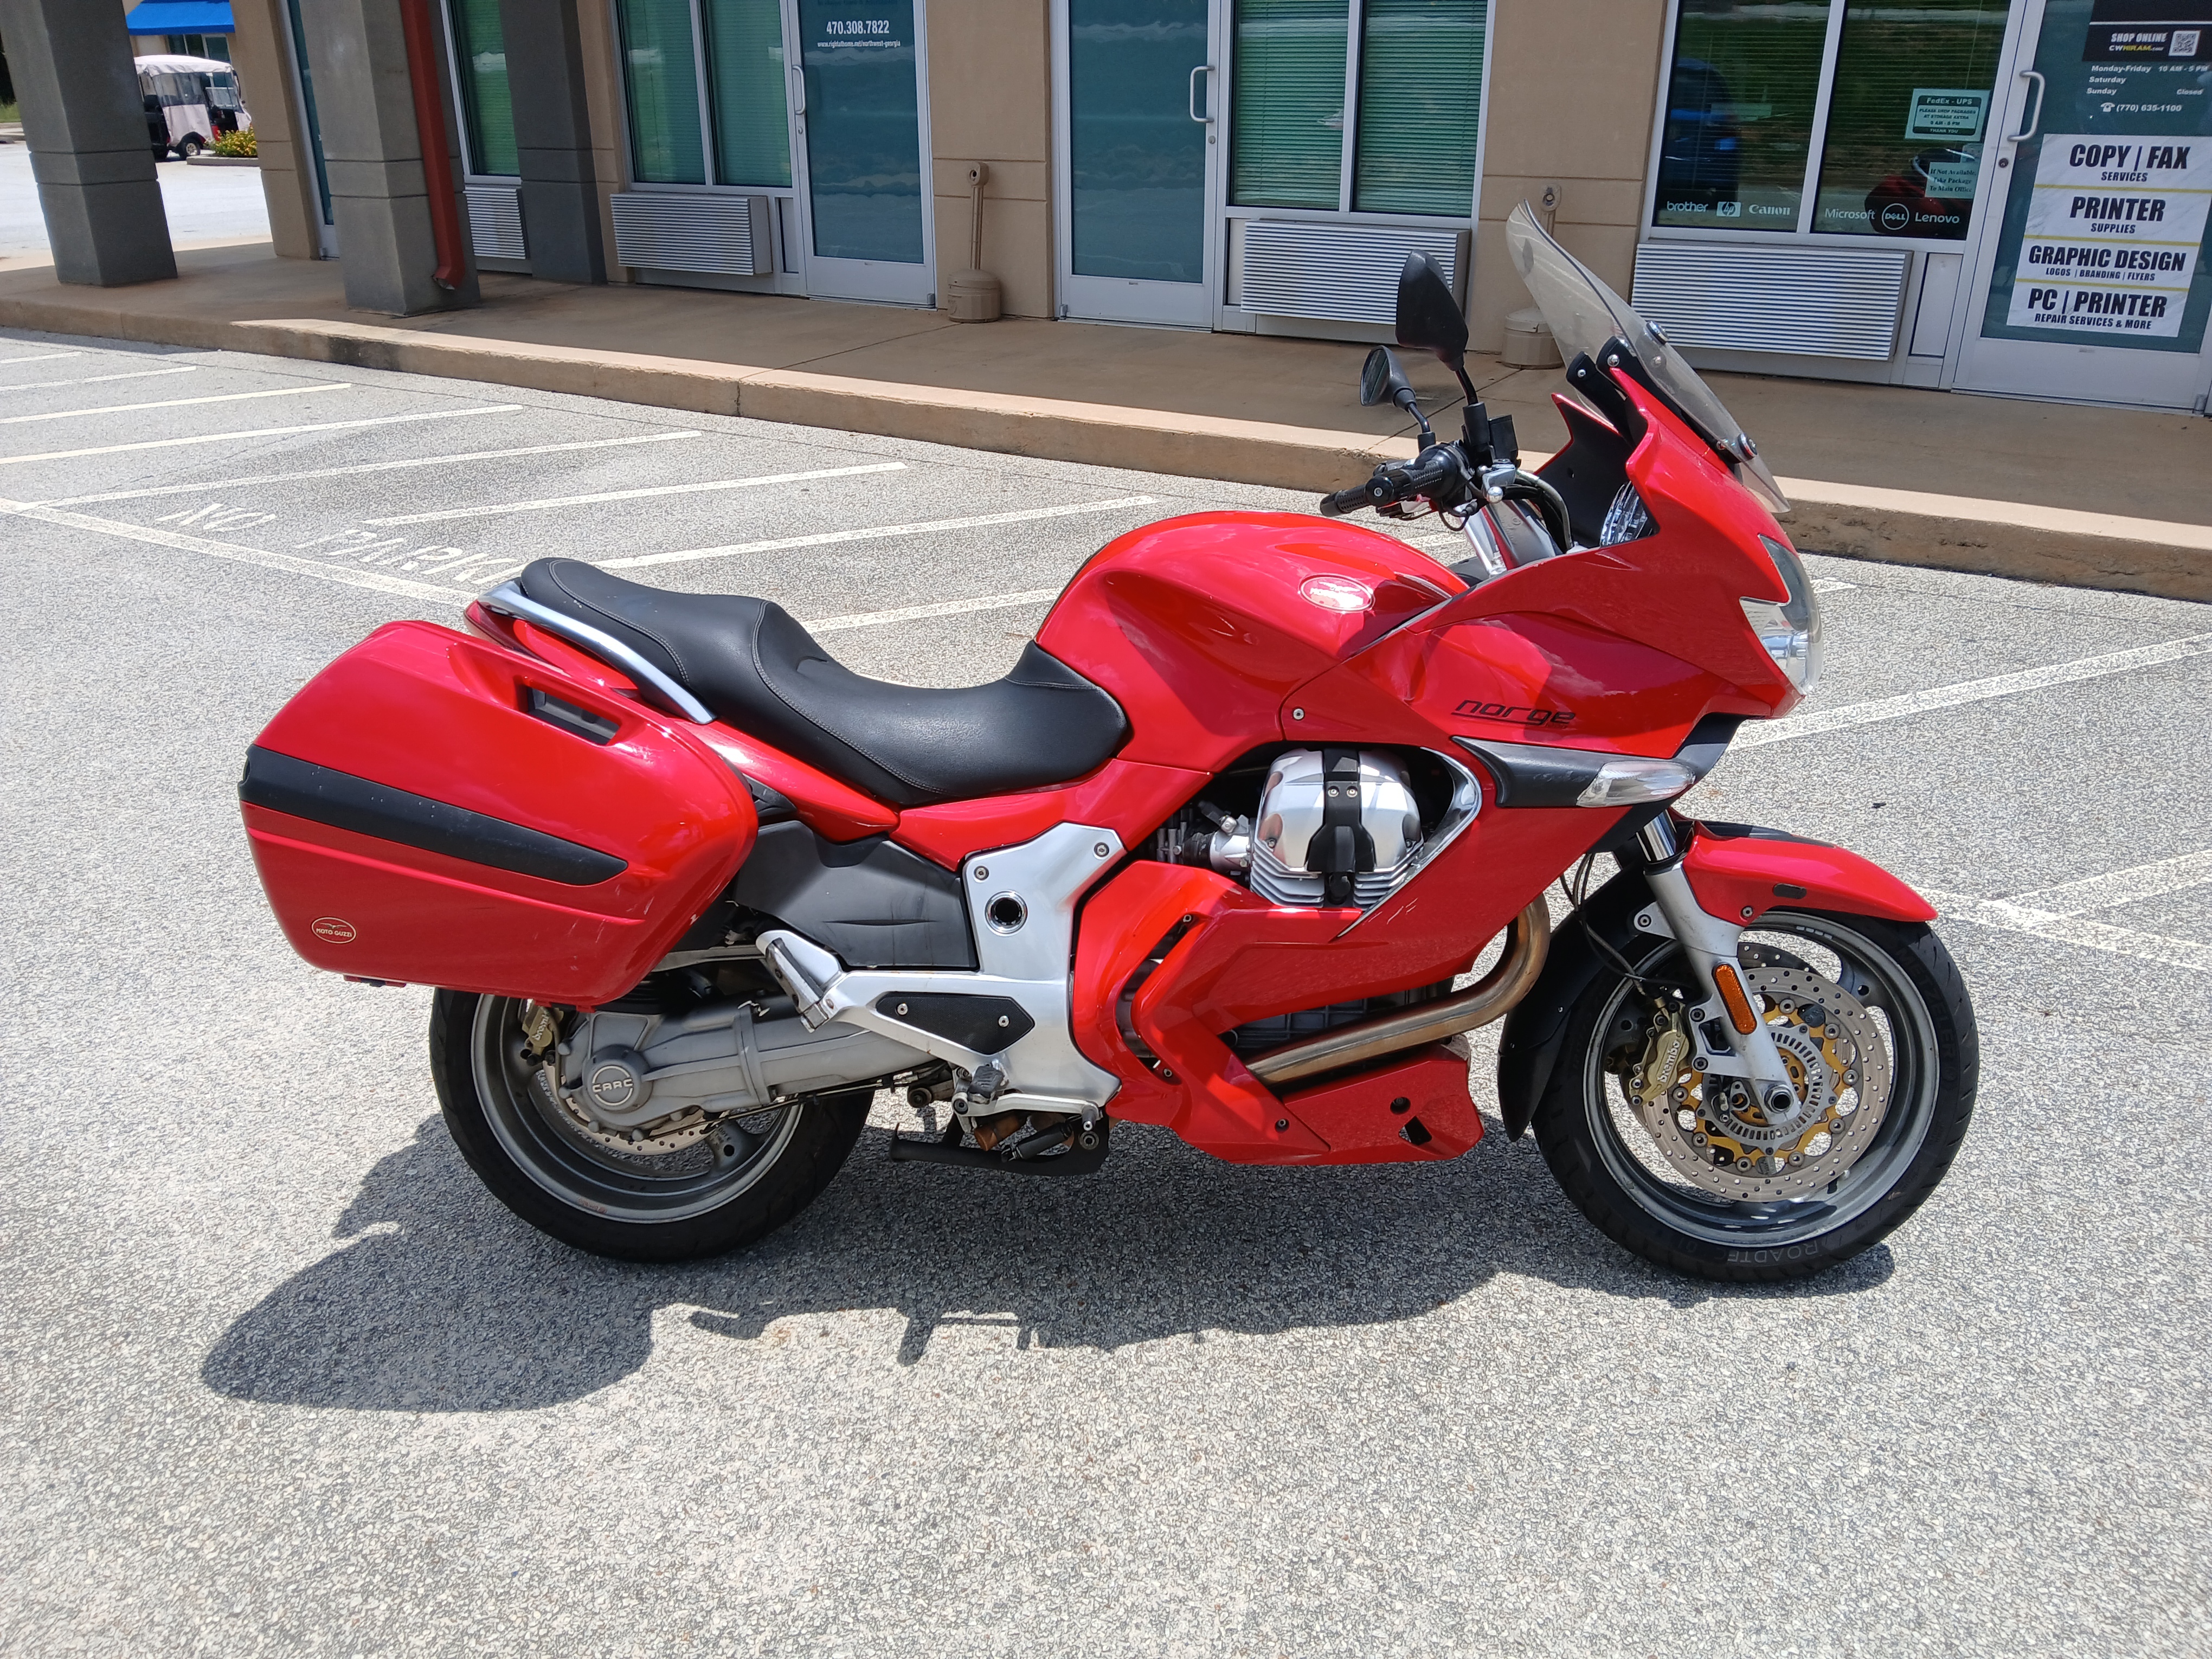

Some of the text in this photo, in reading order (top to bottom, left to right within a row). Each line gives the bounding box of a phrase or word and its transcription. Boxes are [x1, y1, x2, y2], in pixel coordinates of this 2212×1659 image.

[826, 20, 890, 34] 470.308.7822
[2111, 32, 2168, 42] SHOP ONLINE
[2089, 76, 2126, 84] Saturday
[2069, 144, 2132, 168] COPY
[2146, 146, 2190, 169] FAX
[2101, 171, 2148, 182] SERVICES
[1667, 201, 1708, 213] brother
[1748, 204, 1791, 215] Canon
[2069, 196, 2166, 222] PRINTER
[1825, 208, 1876, 220] Microsoft
[1915, 212, 1960, 224] Lenovo
[2091, 223, 2136, 234] SUPPLIES
[2028, 245, 2187, 272] GRAPHIC DESIGN
[2046, 268, 2071, 276] LOGOS
[2079, 269, 2121, 280] BRANDING
[2127, 272, 2156, 281] FLYERS
[2028, 288, 2058, 310] PC
[2073, 291, 2168, 318] PRINTER
[2034, 313, 2152, 330] REPAIR SERVICES & MORE
[1451, 699, 1576, 725] norge
[1657, 1039, 1681, 1083] brembo
[592, 1078, 633, 1093] CARC
